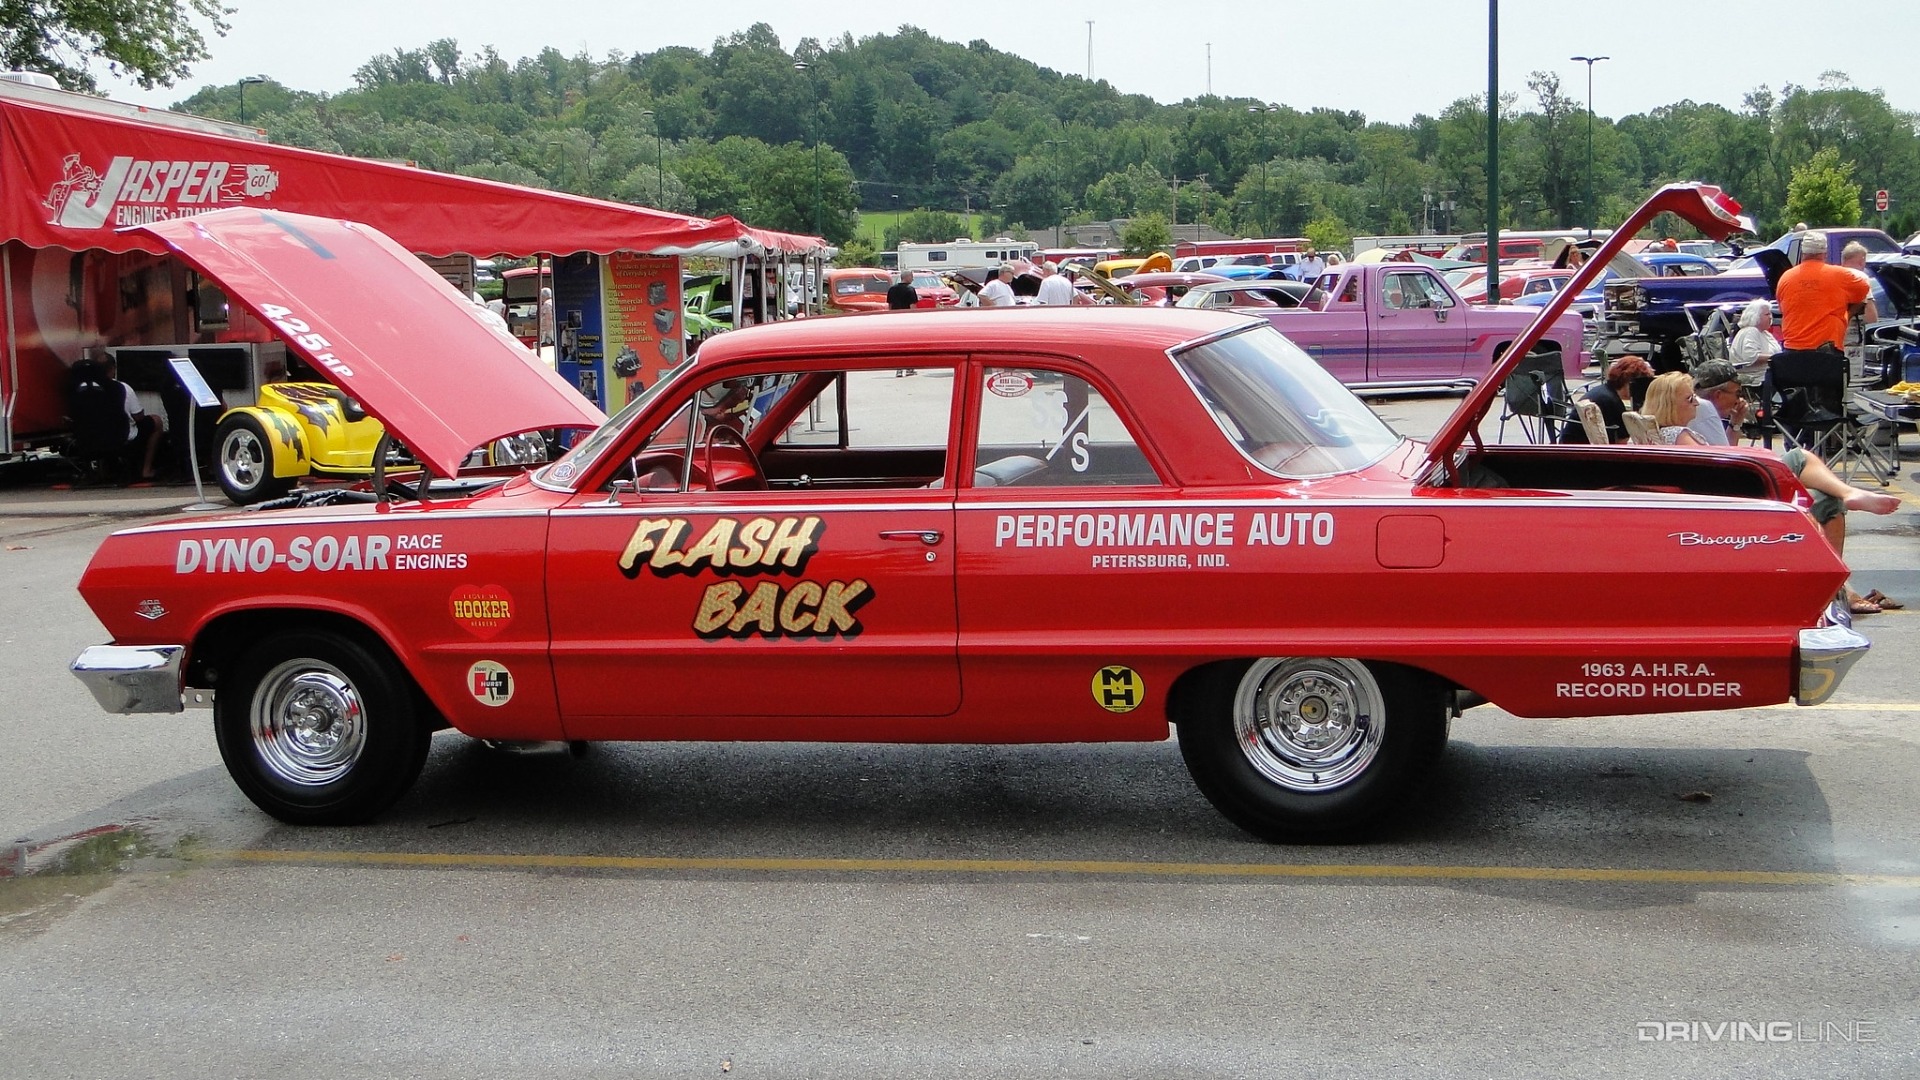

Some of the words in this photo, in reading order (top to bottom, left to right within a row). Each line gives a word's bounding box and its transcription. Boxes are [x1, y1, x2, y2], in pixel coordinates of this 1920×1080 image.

[250, 174, 270, 189] GO!
[61, 156, 230, 229] JASPER
[116, 205, 168, 226] ENGINES
[608, 282, 641, 290] Automotive
[260, 303, 332, 351] 425
[317, 352, 354, 378] HP
[995, 512, 1235, 548] PERFORMANCE
[1247, 512, 1335, 546] AUTO
[397, 534, 443, 550] RACE
[618, 516, 823, 576] FLASH
[1667, 531, 1786, 550] Biscayne
[176, 535, 392, 574] DYNO-SOAR
[395, 553, 468, 570] ENGINES
[1092, 554, 1193, 570] PETERSBURG,
[1197, 554, 1230, 568] IND.
[454, 600, 511, 619] HOOKER
[692, 579, 873, 638] BACK
[1581, 663, 1625, 677] 1963
[1631, 663, 1715, 677] A.H.R.A.
[1556, 683, 1646, 697] RECORD
[1653, 682, 1742, 697] HOLDER
